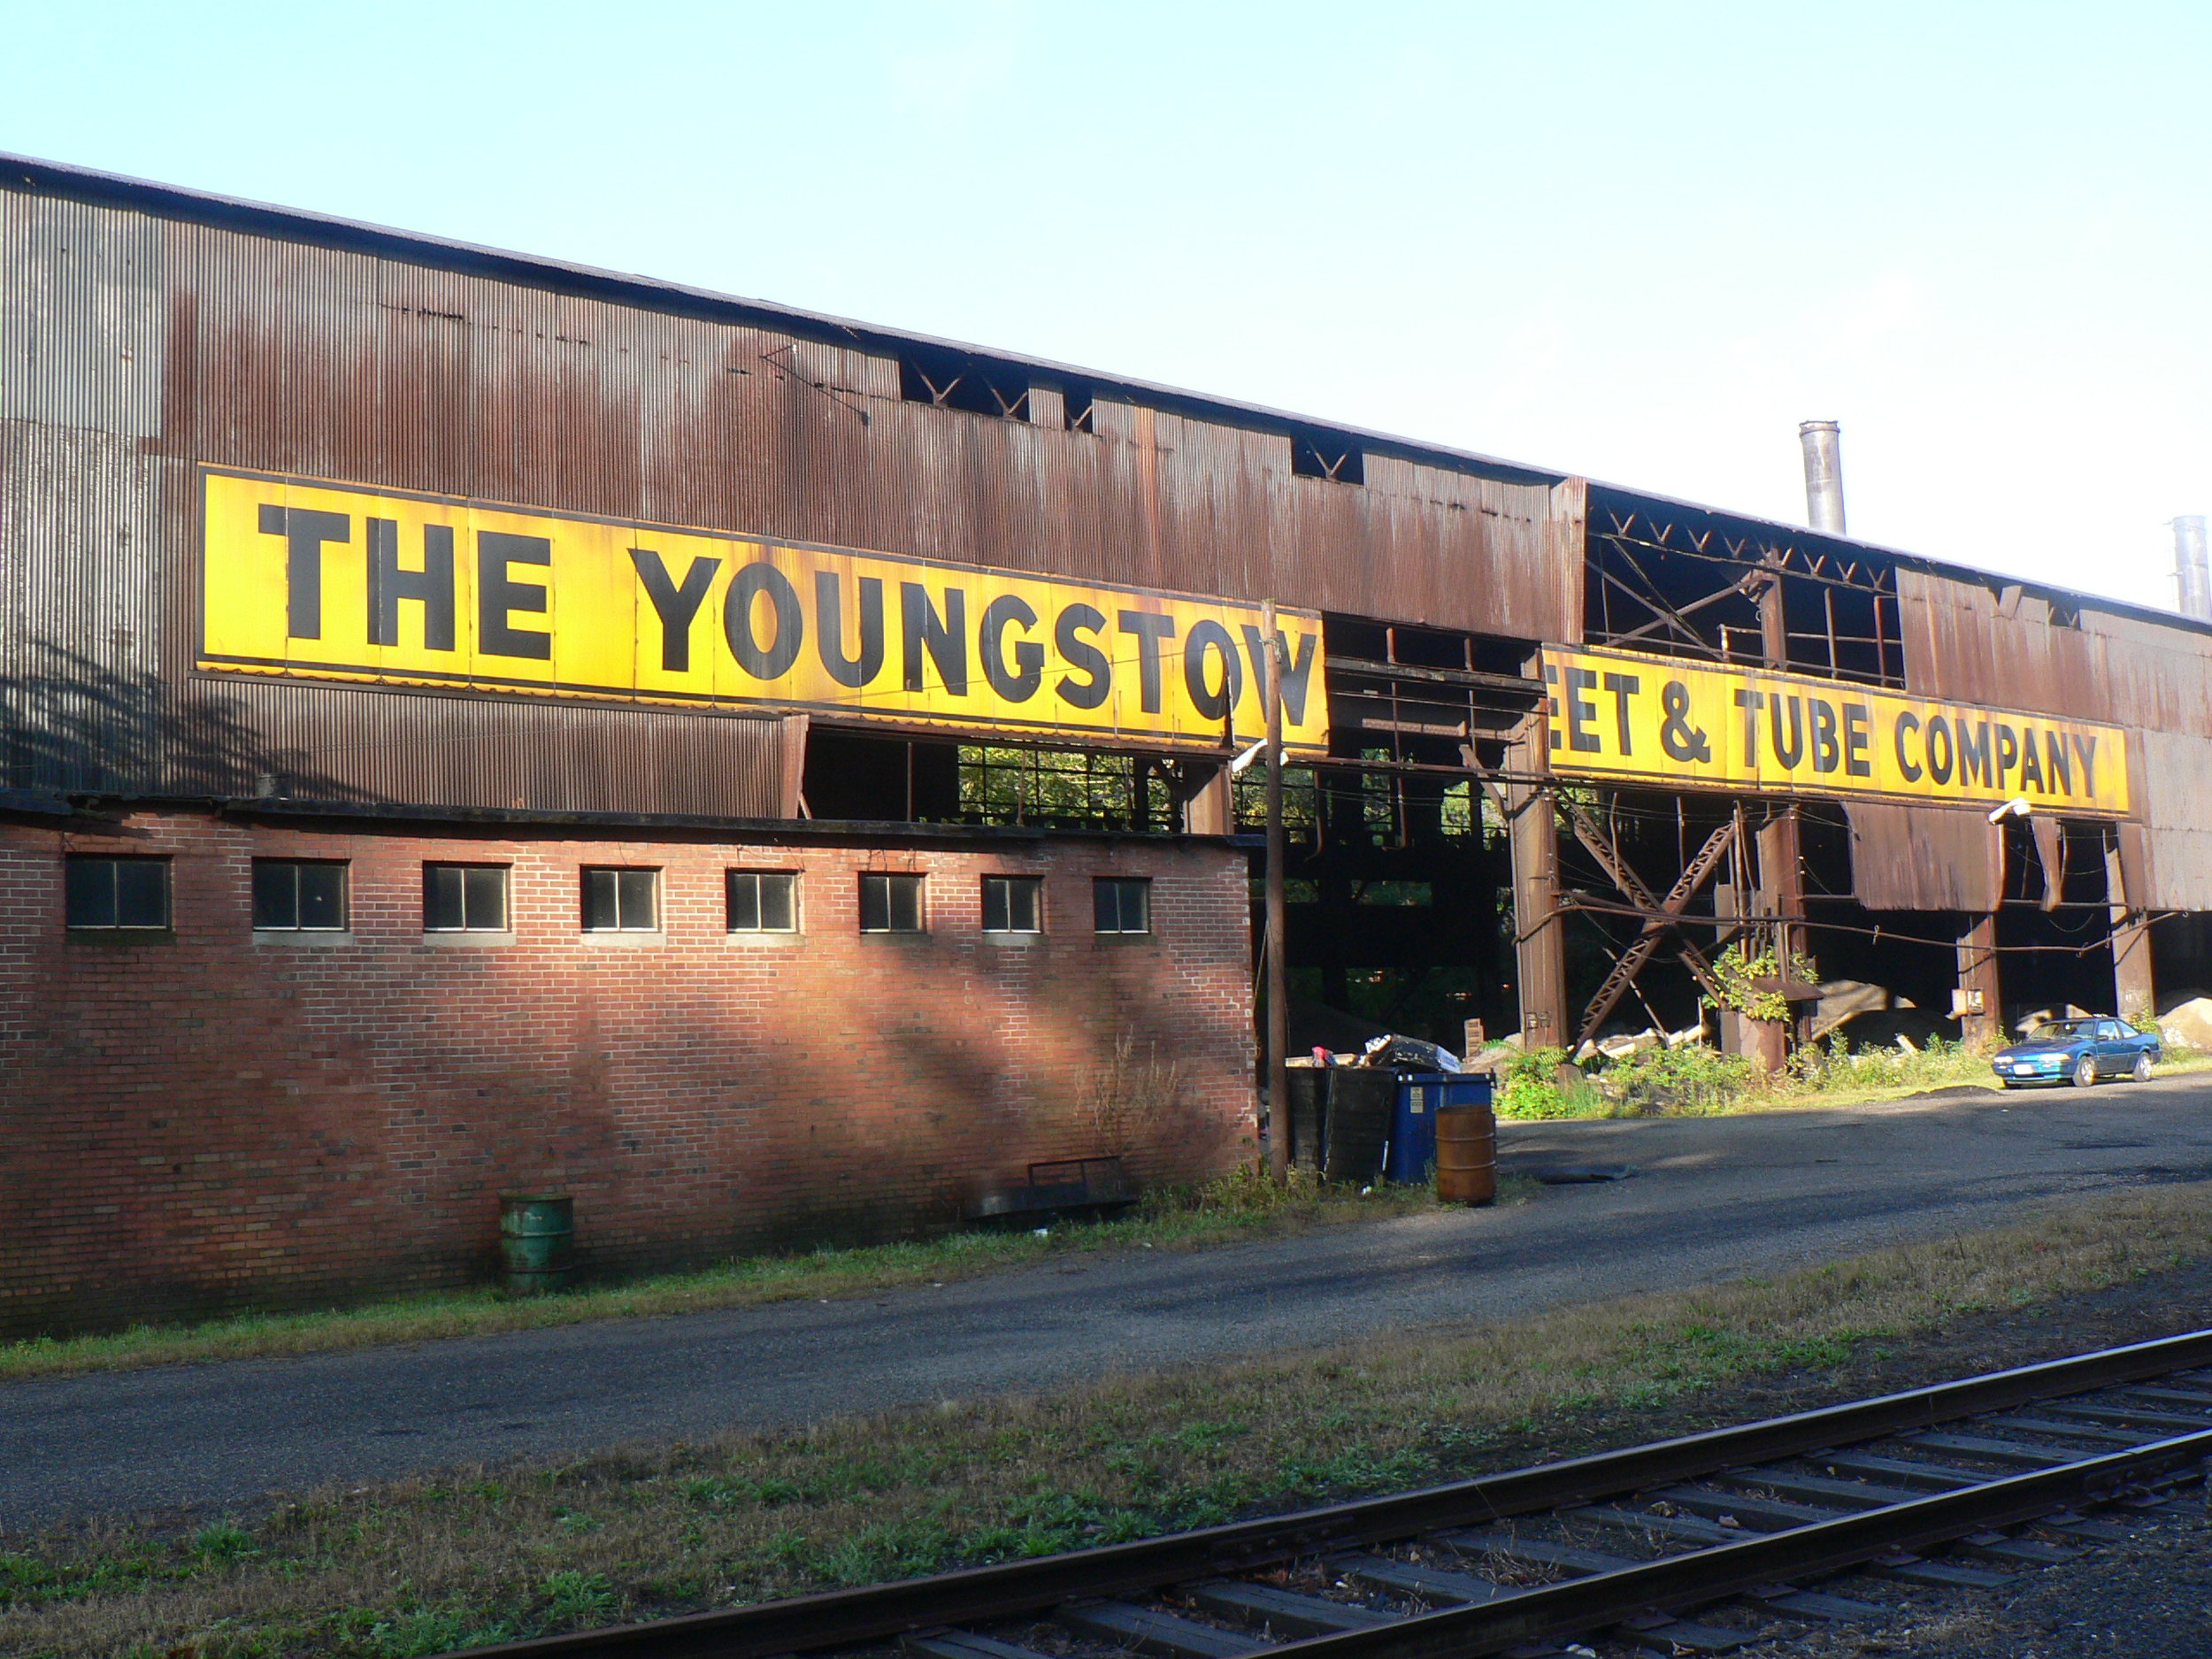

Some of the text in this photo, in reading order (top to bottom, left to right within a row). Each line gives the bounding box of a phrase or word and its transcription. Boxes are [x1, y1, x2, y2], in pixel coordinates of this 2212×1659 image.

[258, 503, 550, 660] THE
[1661, 681, 1710, 764] &
[1734, 688, 1871, 777] TUBE
[1894, 710, 2098, 798] COMPANY
